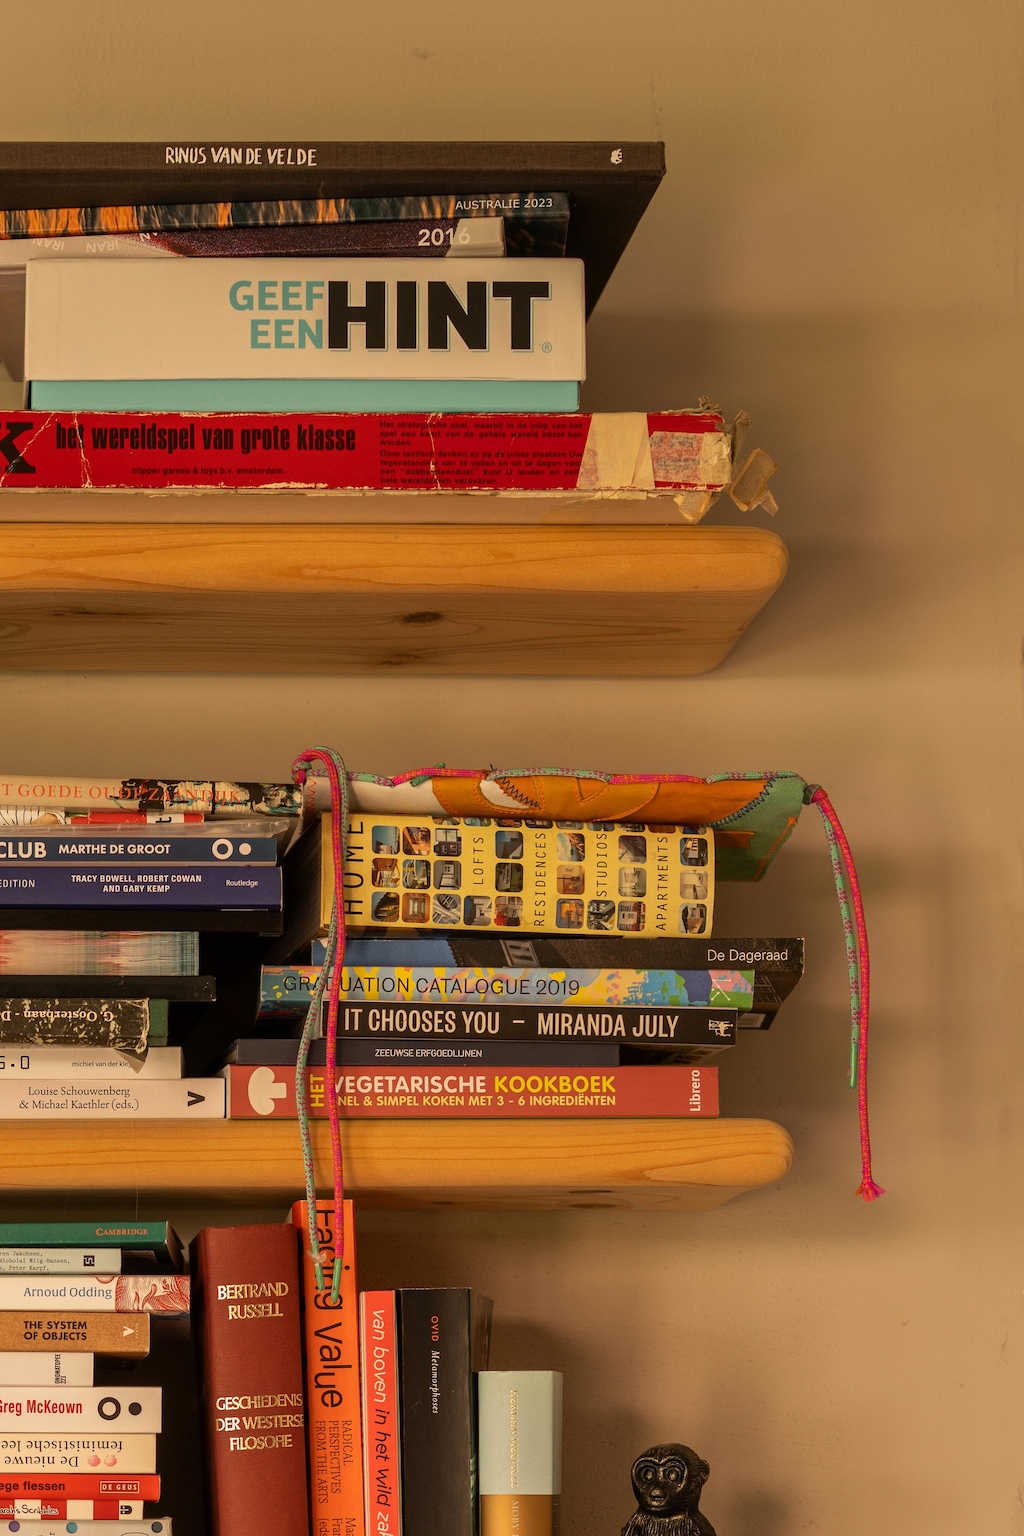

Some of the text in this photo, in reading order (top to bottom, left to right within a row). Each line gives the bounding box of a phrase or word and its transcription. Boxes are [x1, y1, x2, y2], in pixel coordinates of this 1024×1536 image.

[165, 147, 317, 166] RINUS VAN DE VELDE
[455, 197, 552, 210] AUSTRALIE 2023
[418, 228, 471, 247] 2016
[229, 281, 325, 311] GEEF
[328, 281, 552, 352] HINT
[250, 319, 323, 349] EEN
[56, 423, 356, 454] het wereldspel van grote klasse
[59, 845, 104, 855] MARTHE
[108, 845, 124, 855] DE
[127, 845, 170, 855] GROOT
[473, 836, 484, 884] LOFTS
[597, 833, 608, 898] STUDIOS
[226, 879, 258, 888] Routledge
[534, 833, 546, 926] RESIDENCES
[656, 836, 668, 930] APARTMENTS
[707, 948, 788, 965] De Dageraad
[344, 1010, 360, 1031] IT
[368, 1010, 455, 1033] CHOOSES
[462, 1011, 500, 1034] YOU
[537, 1013, 627, 1036] MIRANDA
[633, 1015, 678, 1039] JULY
[375, 1049, 483, 1058] ZEEUWSE ERFGOEDLIJNEN
[335, 1075, 616, 1094] VEGETARISCHE KOOKBOEK
[217, 1281, 288, 1300] BERTRAND
[228, 1303, 283, 1319] RUSSELL
[26, 1399, 82, 1414] McKeown
